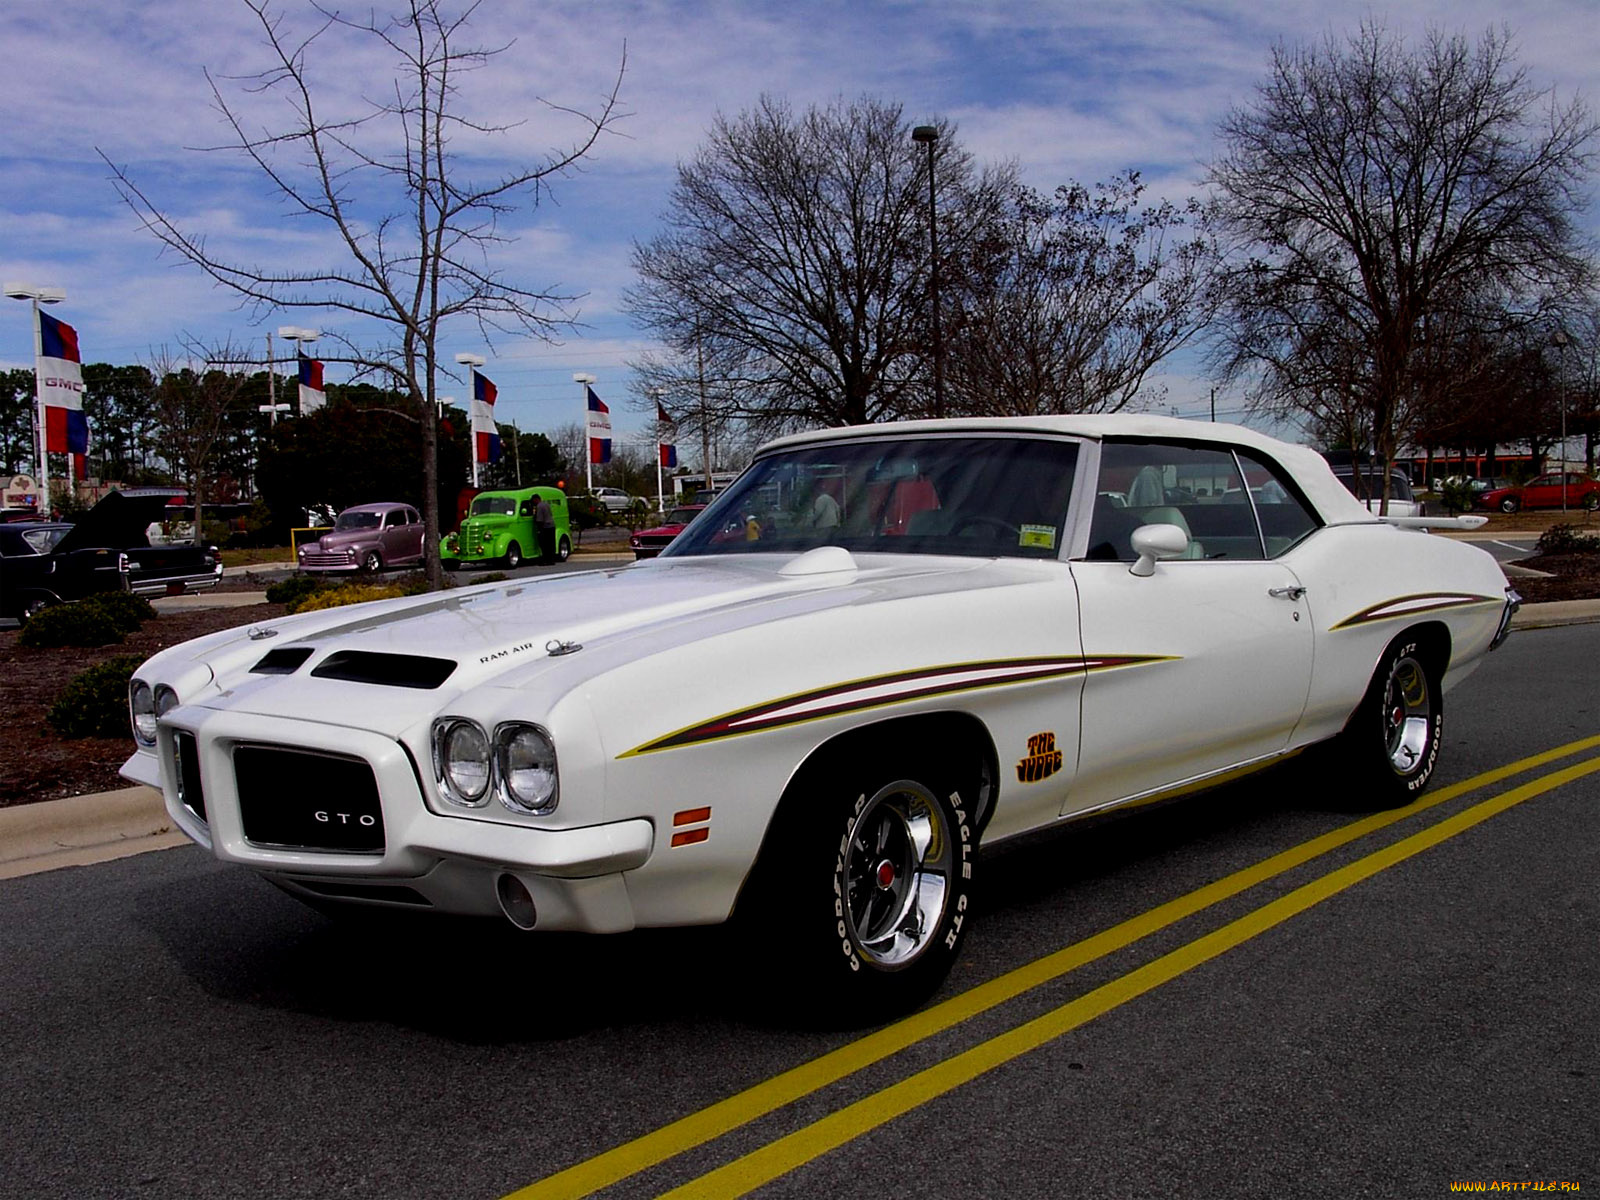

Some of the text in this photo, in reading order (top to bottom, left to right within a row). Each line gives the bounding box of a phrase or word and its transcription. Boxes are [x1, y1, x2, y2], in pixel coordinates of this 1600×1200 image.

[45, 377, 82, 392] GMC
[480, 642, 533, 664] RAM AIR
[1027, 731, 1056, 757] THE
[1015, 749, 1063, 783] JUDGE
[314, 810, 376, 826] GTO
[949, 791, 972, 880] EAGLE
